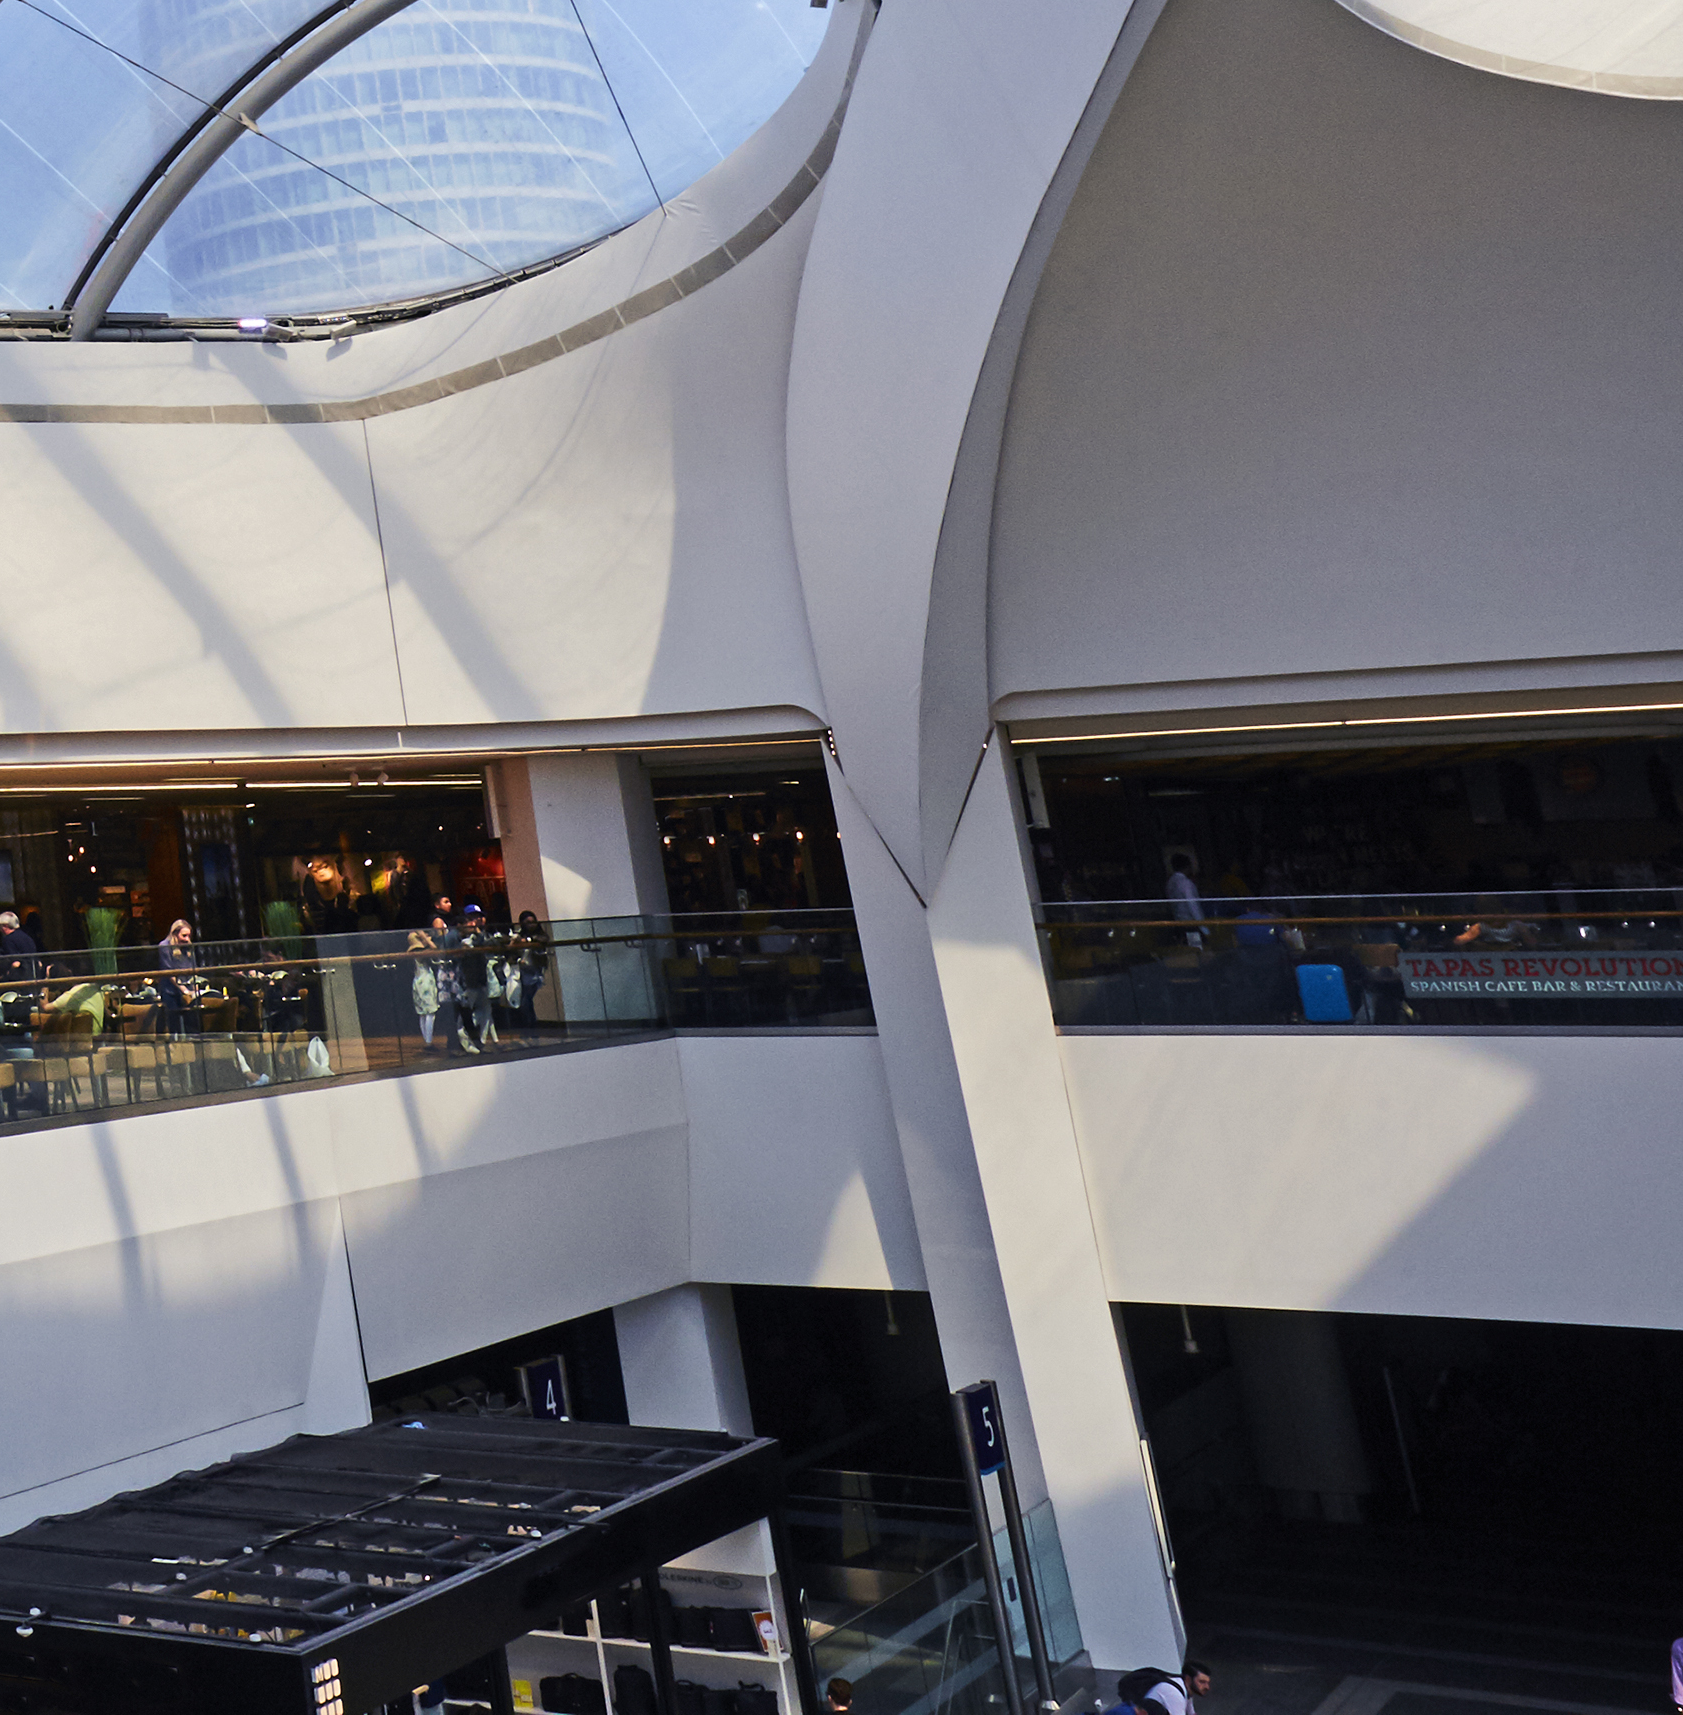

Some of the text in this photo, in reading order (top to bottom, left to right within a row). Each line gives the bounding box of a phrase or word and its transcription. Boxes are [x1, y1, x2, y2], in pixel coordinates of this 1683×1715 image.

[1406, 958, 1494, 978] TAPAS
[1410, 980, 1480, 993] SPANISH
[1484, 980, 1528, 993] CAFE
[1533, 980, 1567, 993] BAR
[1569, 980, 1582, 993] &
[546, 1378, 557, 1416] 4
[981, 1405, 995, 1448] 5
[659, 1572, 704, 1584] OLESKINE
